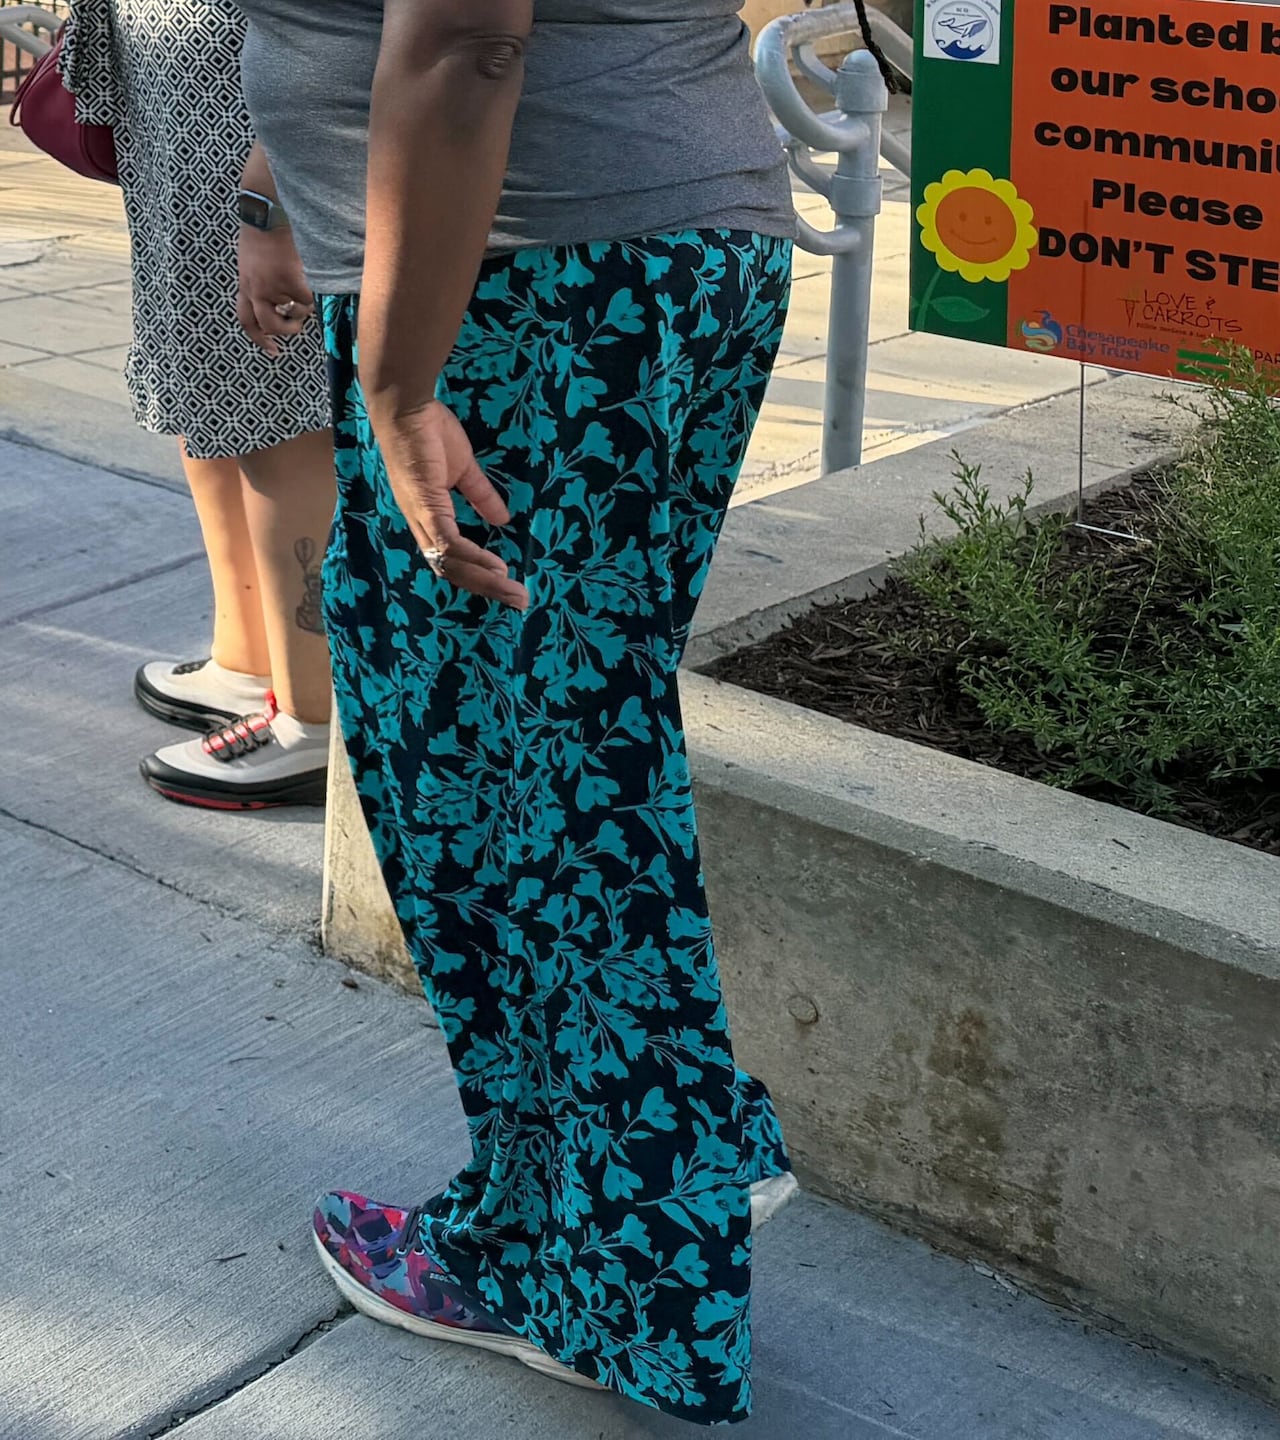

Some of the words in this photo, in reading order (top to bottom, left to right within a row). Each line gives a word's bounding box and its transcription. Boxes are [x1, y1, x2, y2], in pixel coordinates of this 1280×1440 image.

[1049, 4, 1249, 52] Planted
[1050, 67, 1140, 98] our
[1150, 77, 1280, 114] scho
[1034, 121, 1280, 174] communi
[1092, 178, 1264, 230] Please
[1038, 226, 1174, 274] DON'T
[1142, 303, 1243, 333] CARROTS
[1144, 289, 1197, 311] LOVE
[1066, 323, 1171, 353] Chesapeake
[1066, 337, 1097, 357] Bay
[1100, 342, 1141, 361] Trust
